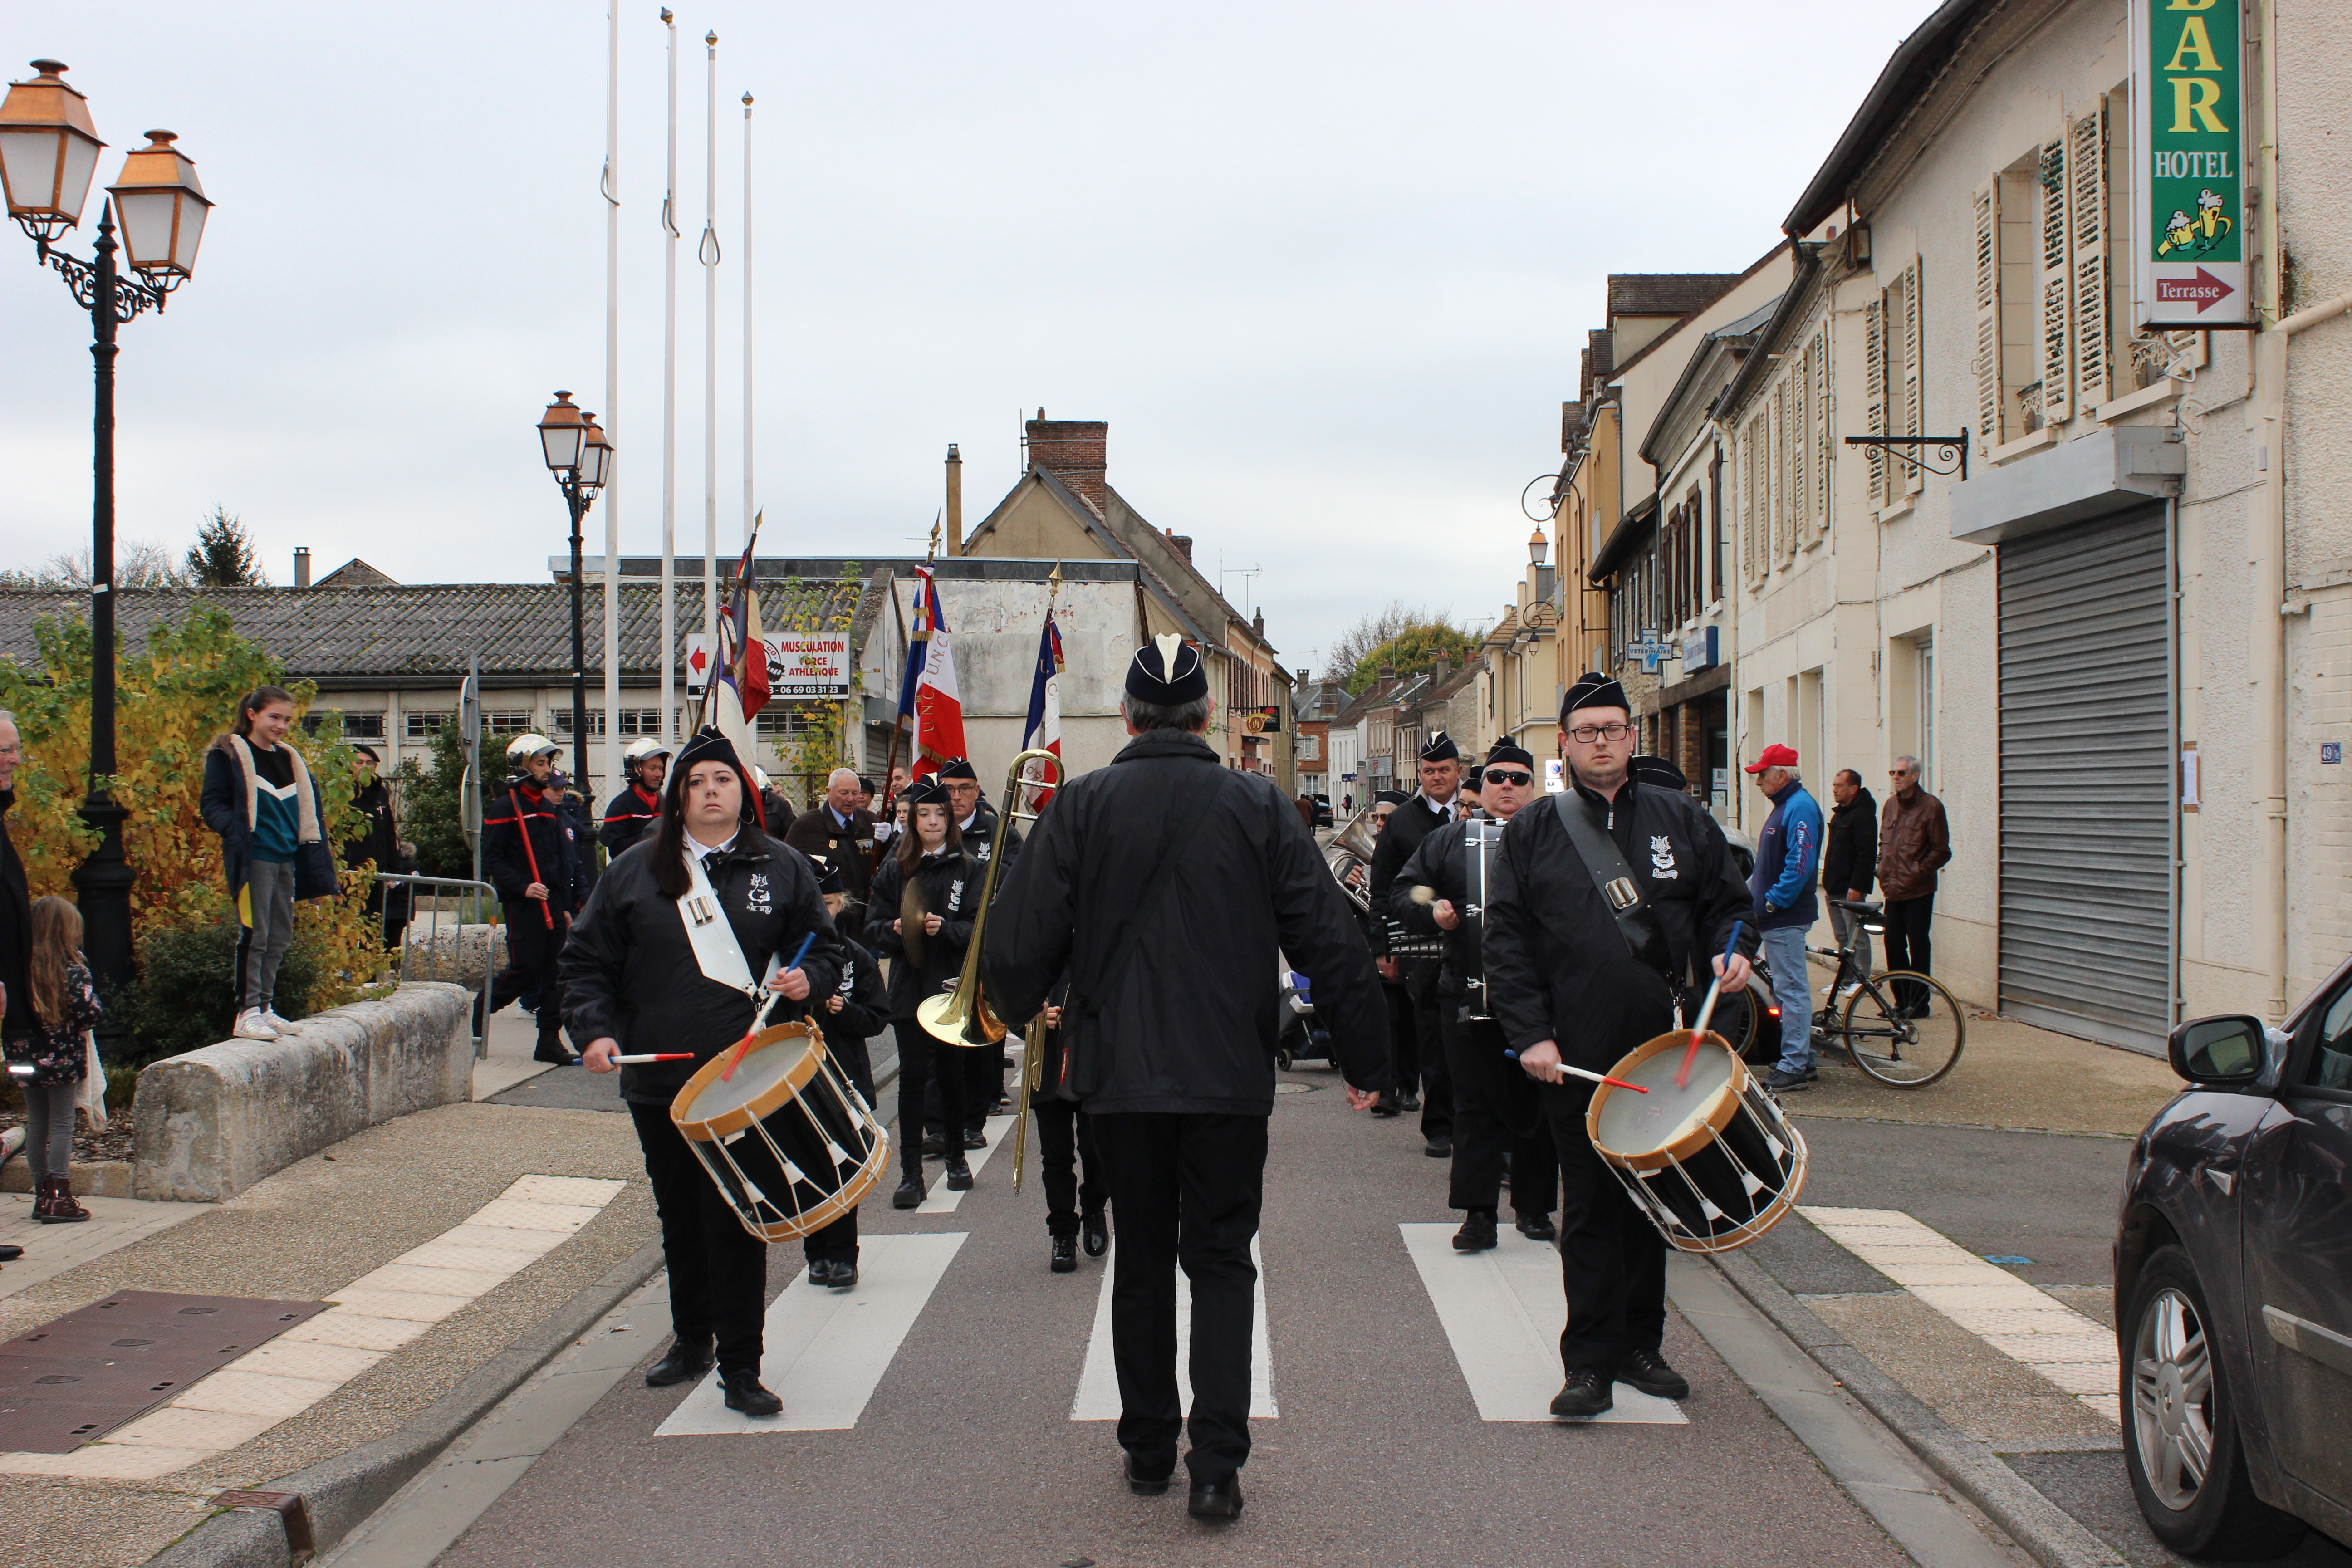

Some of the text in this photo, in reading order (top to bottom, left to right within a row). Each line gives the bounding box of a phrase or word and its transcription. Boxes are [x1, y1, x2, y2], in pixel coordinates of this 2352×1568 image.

[2163, 0, 2229, 132] AR
[2154, 151, 2233, 179] HOTEL
[2160, 282, 2220, 298] Terrasse
[2322, 746, 2332, 760] 49
